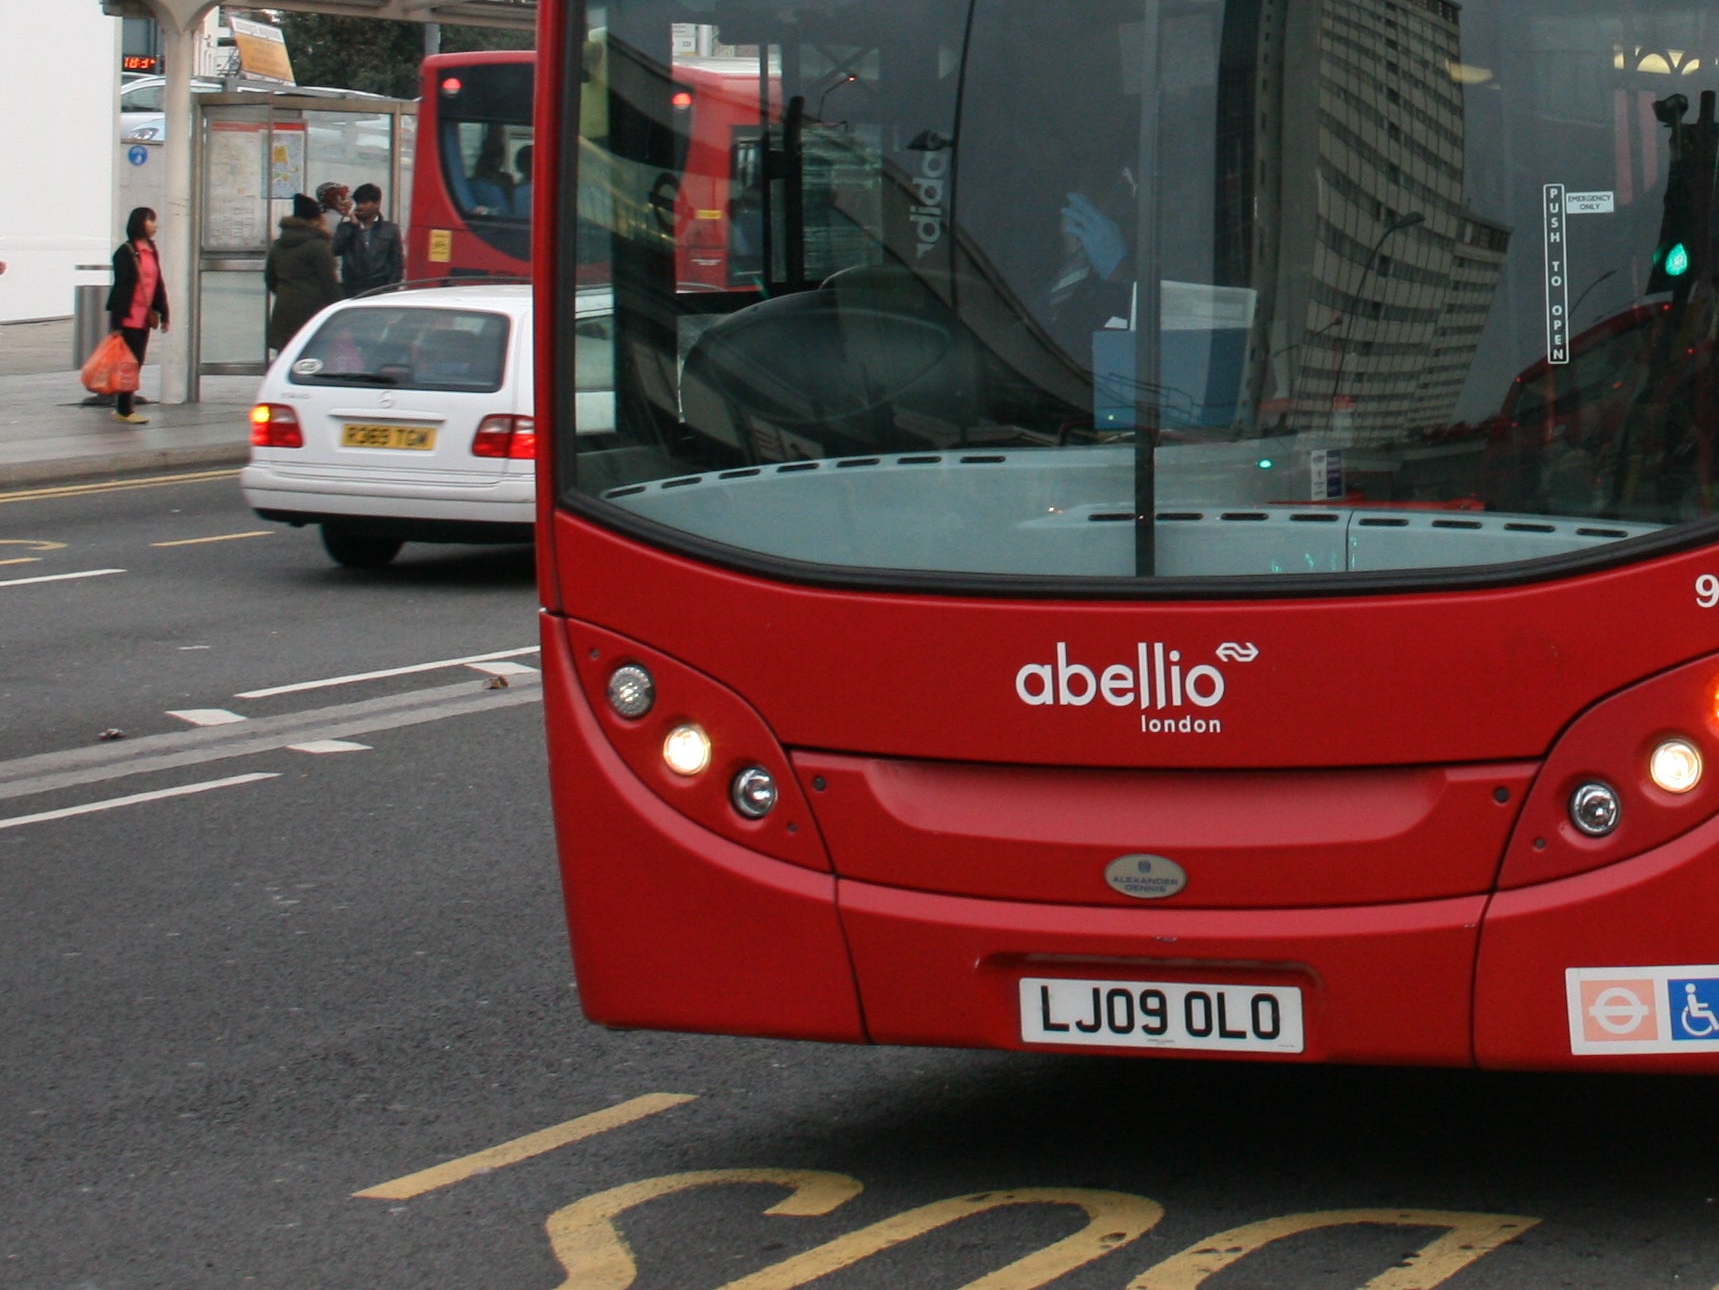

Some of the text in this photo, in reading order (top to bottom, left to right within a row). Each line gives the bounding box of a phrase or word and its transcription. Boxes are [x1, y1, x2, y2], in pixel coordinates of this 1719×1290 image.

[1567, 194, 1612, 203] EMERGENCY
[1579, 202, 1600, 211] ONLY
[1549, 188, 1564, 360] PUSH TO OPEN
[1014, 641, 1226, 711] abellio
[1140, 714, 1222, 734] london
[1111, 876, 1179, 887] ALEXANDER
[1124, 884, 1167, 893] DENNIS
[1040, 985, 1280, 1041] LJ09 OLO
